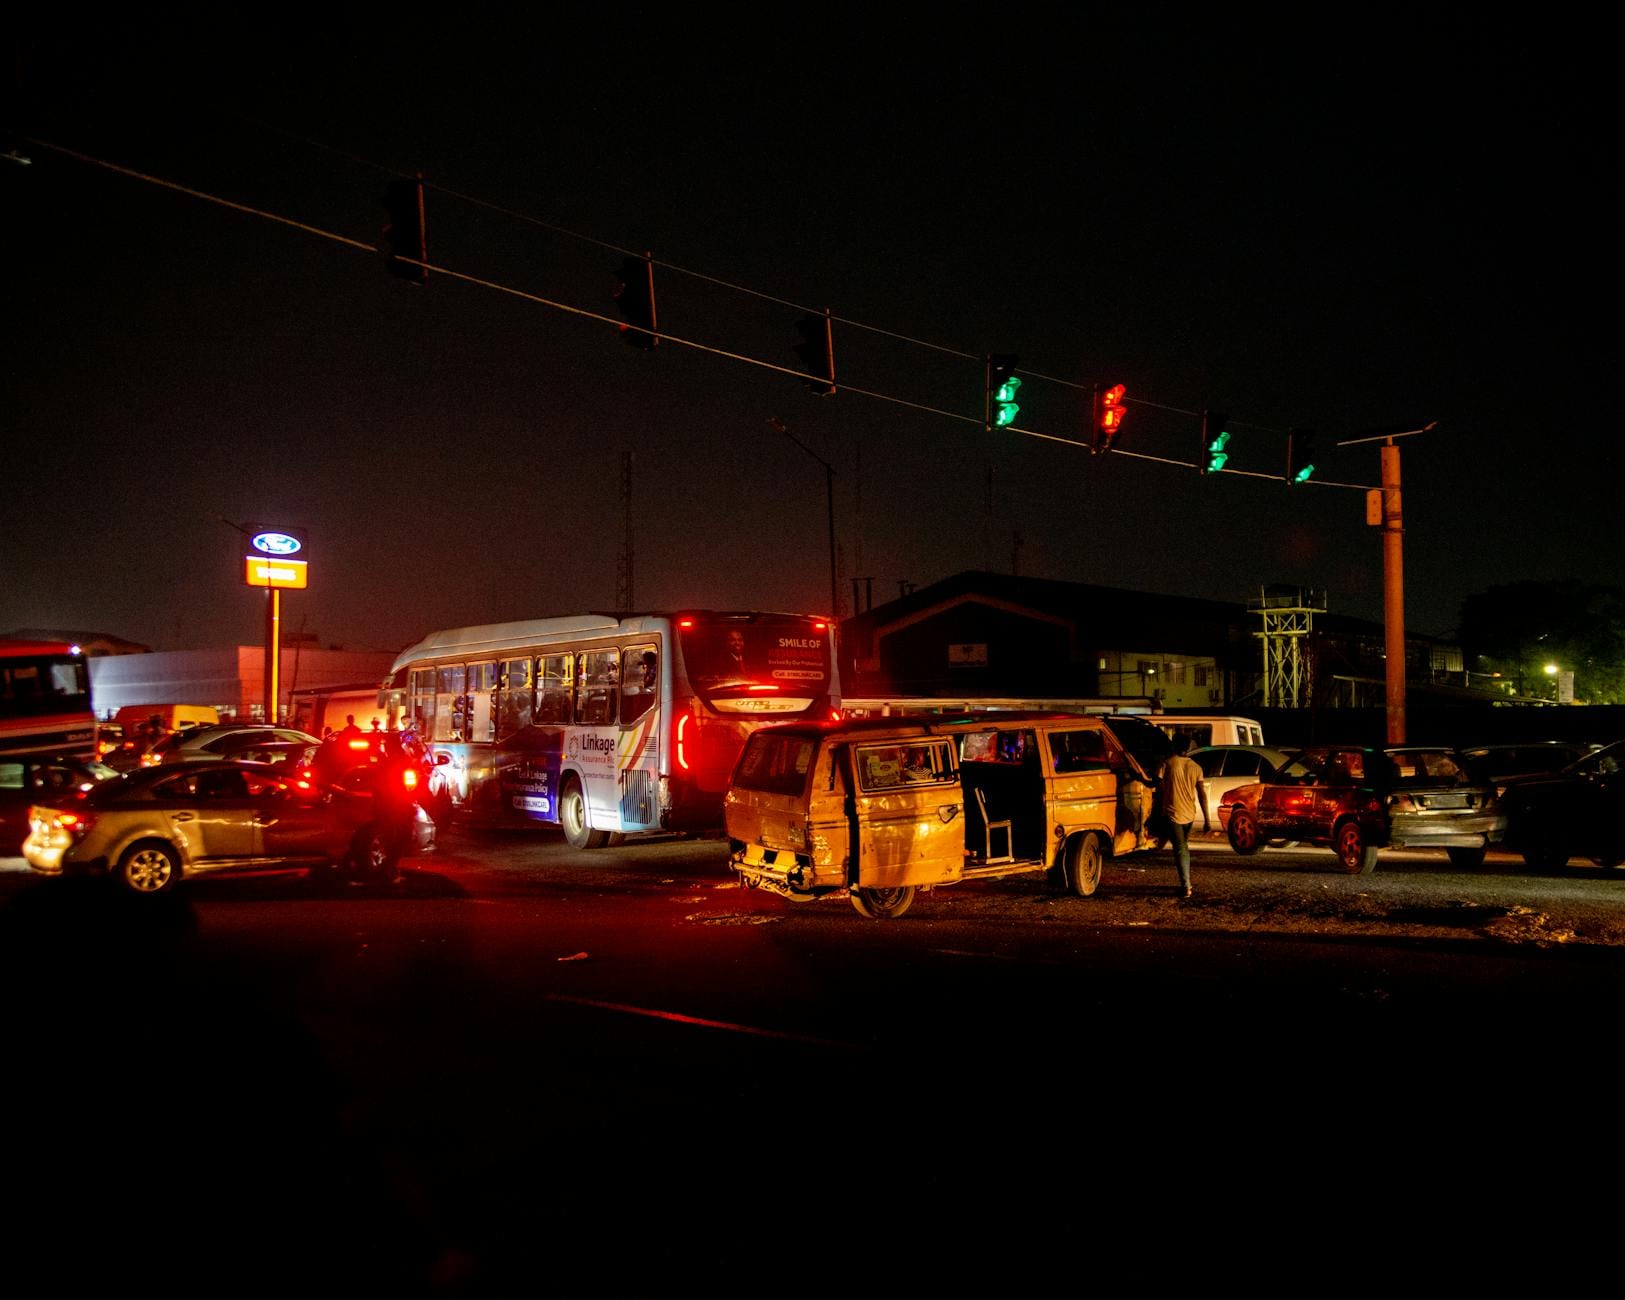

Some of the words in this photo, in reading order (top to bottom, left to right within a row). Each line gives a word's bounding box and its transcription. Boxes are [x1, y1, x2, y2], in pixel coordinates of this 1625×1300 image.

[778, 637, 808, 648] SMILE
[808, 639, 821, 648] OF
[582, 734, 615, 755] Linkage
